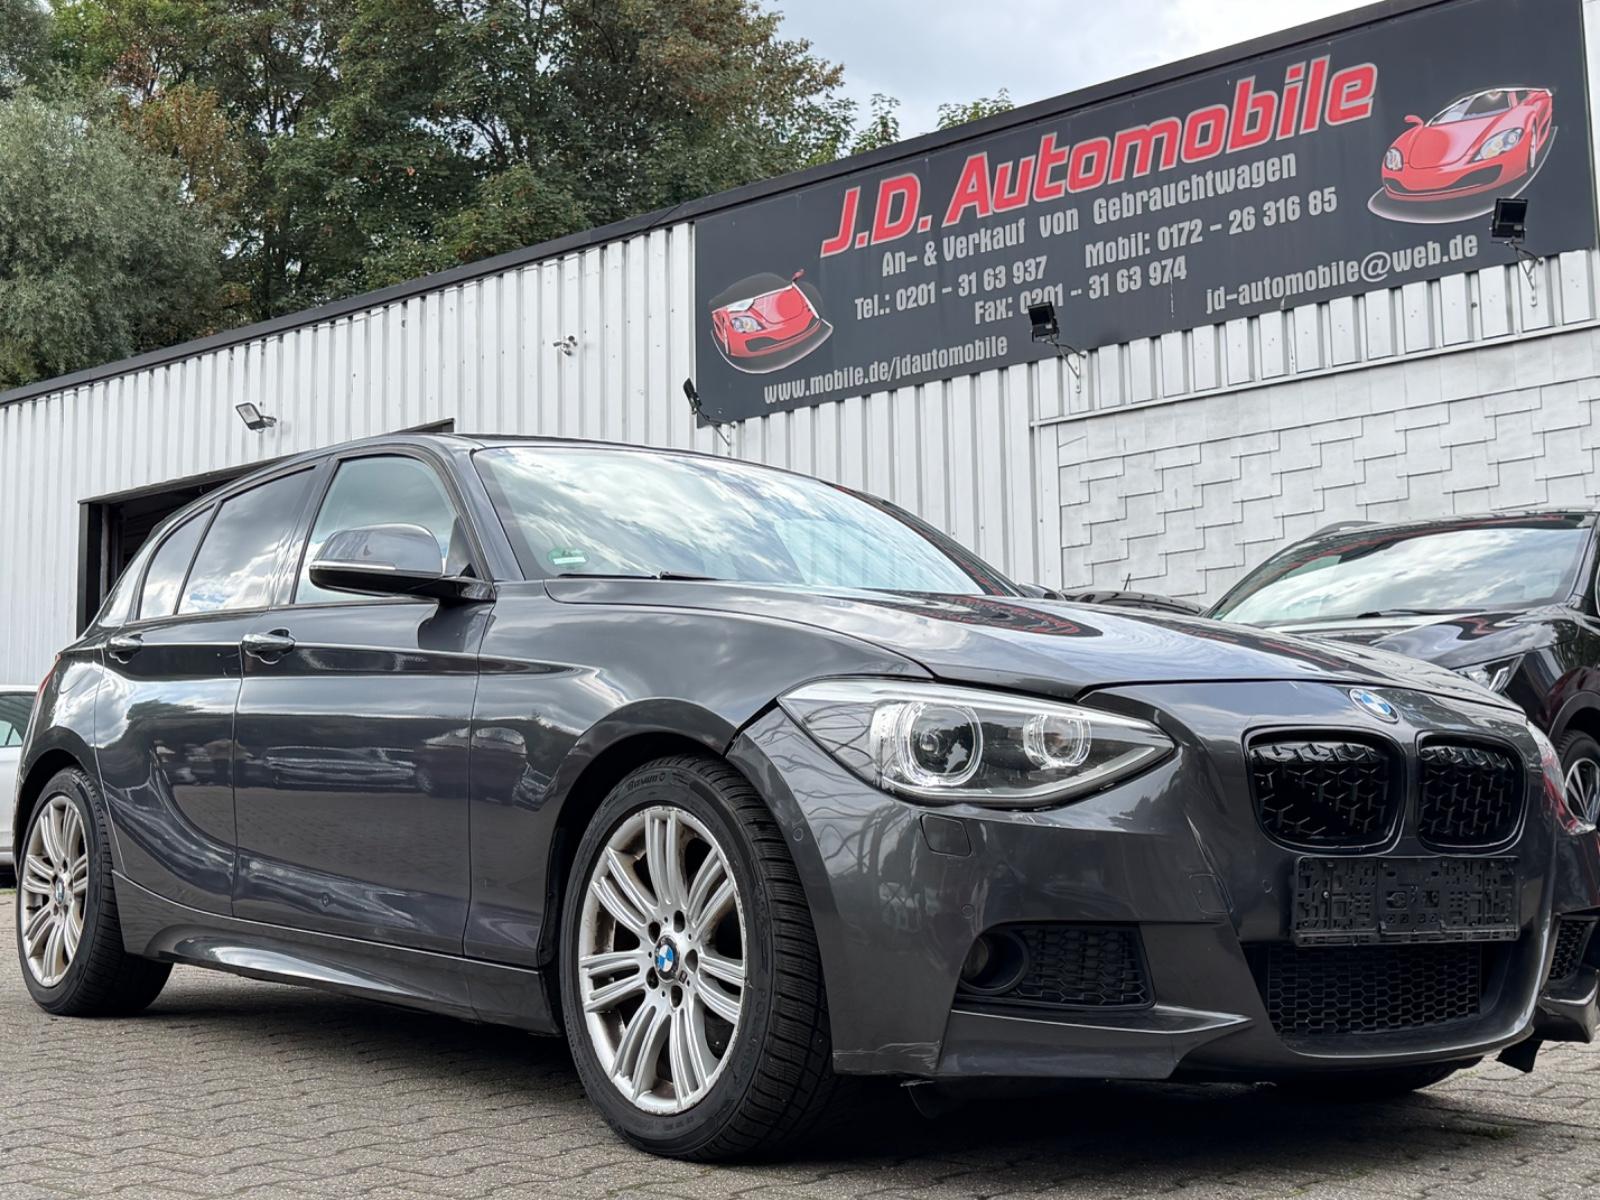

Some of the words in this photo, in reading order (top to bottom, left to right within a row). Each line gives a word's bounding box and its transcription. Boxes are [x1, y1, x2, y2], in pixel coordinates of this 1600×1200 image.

[820, 172, 931, 258] J.D.
[943, 55, 1378, 227] Automobile
[882, 251, 918, 277] An-
[924, 241, 938, 267] &
[943, 218, 1026, 261] Verkauf
[1040, 207, 1079, 237] von
[1093, 153, 1297, 225] Gebrauchtwagen
[1085, 232, 1151, 268] Mobil:
[1157, 219, 1203, 251] 0172
[1229, 207, 1256, 234] 26
[1263, 196, 1301, 226] 316
[1309, 187, 1338, 215] 85
[855, 293, 890, 320] Tel.:
[896, 281, 936, 311] 0201
[958, 272, 977, 297] 31
[983, 266, 1006, 290] 63
[1013, 256, 1048, 285] 937
[974, 296, 1014, 324] Fax:
[1089, 272, 1110, 299] 31
[1117, 266, 1141, 293] 63
[1149, 256, 1187, 286] 974
[1206, 234, 1478, 315] jd-automobile@web.de
[764, 336, 1008, 404] www.mobile.de/jdautomobile
